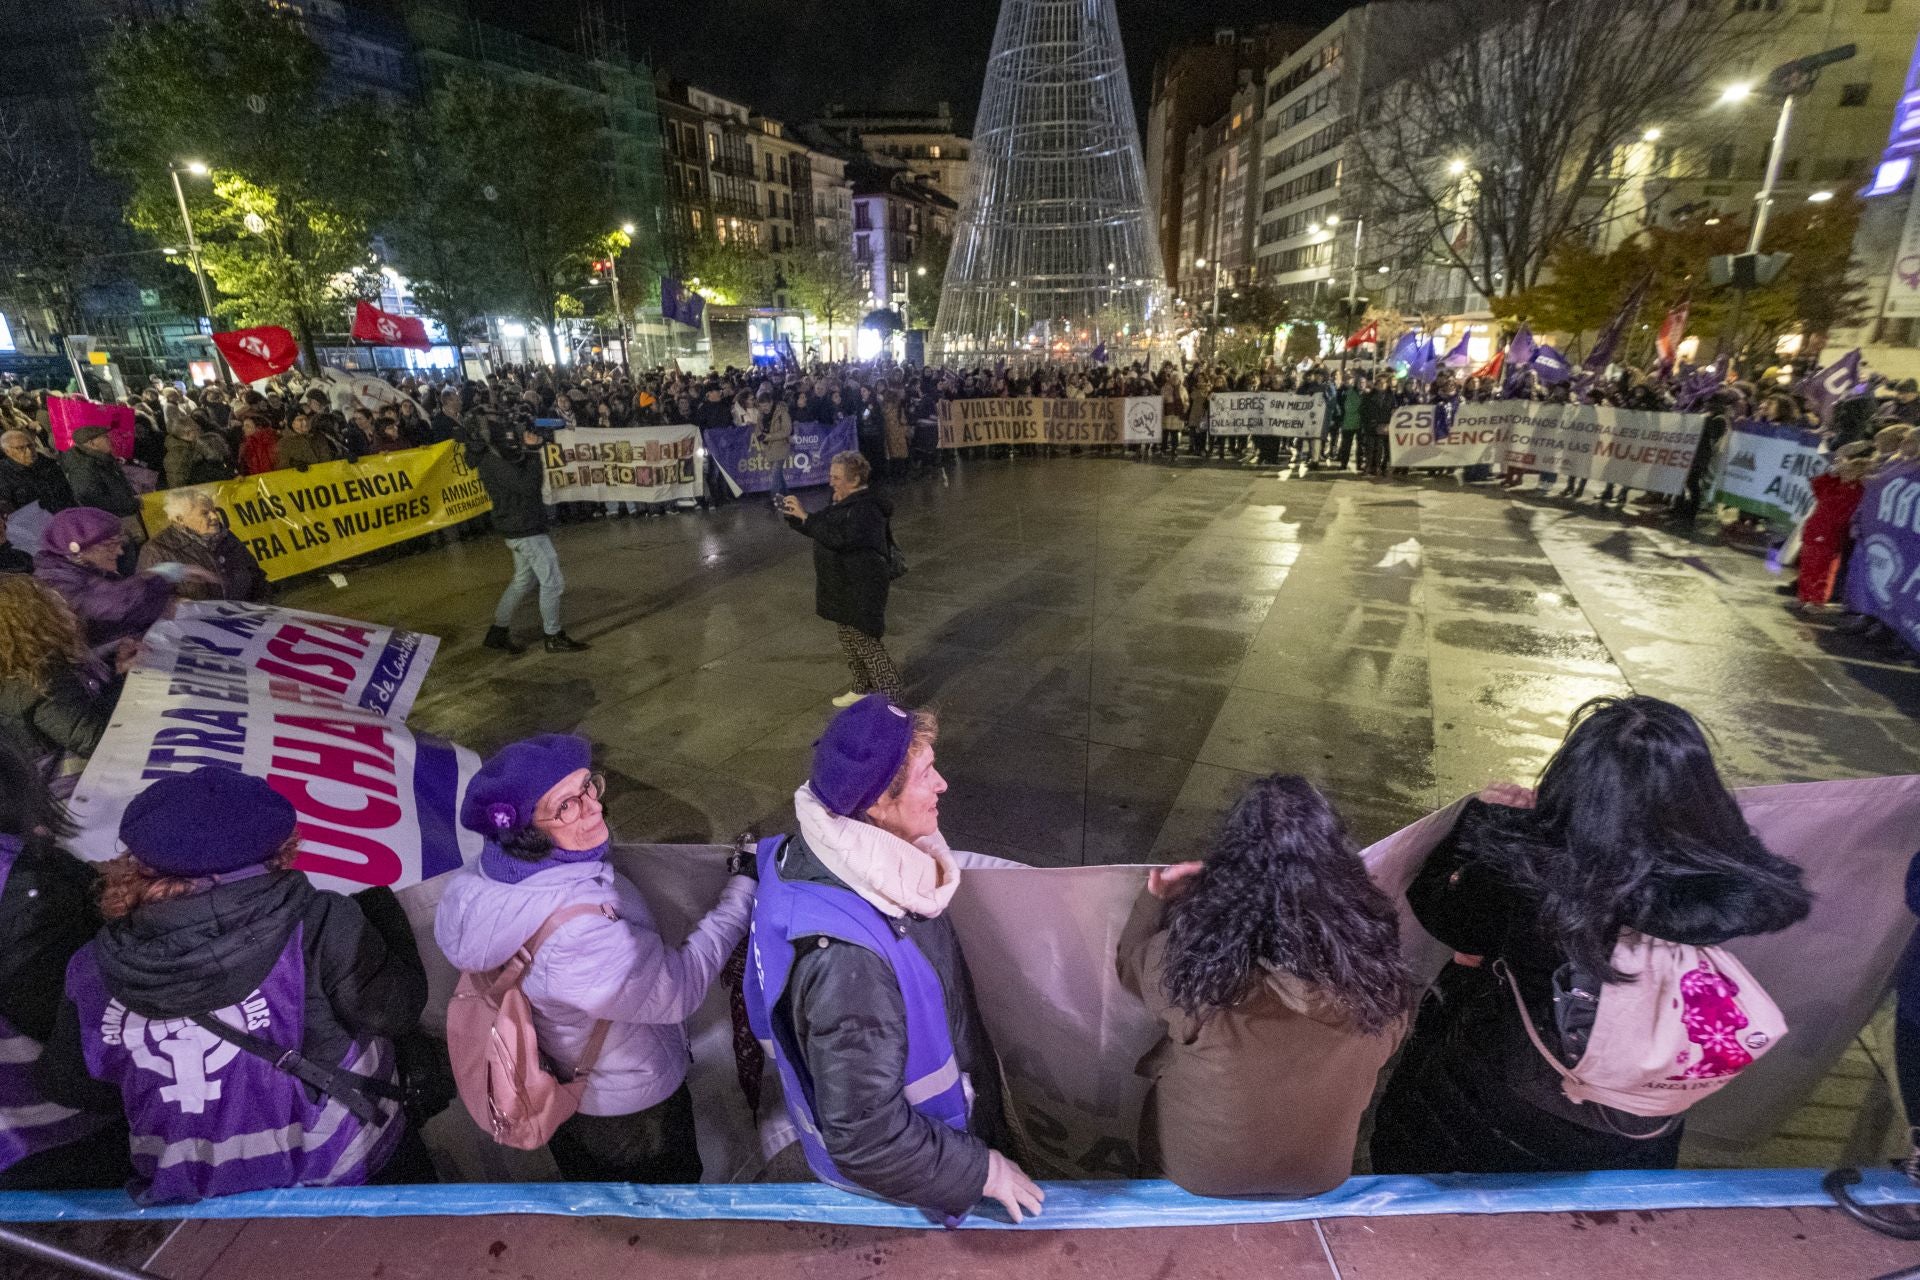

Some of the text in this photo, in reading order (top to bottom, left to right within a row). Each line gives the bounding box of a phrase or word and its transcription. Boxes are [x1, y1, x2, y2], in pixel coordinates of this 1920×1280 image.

[961, 400, 1033, 419] VIOLENCIAS
[1043, 400, 1114, 420] MACHISTAS
[1230, 397, 1314, 411] LIBRES SIN MIEDO
[943, 424, 954, 443] NI
[963, 420, 1038, 443] ACTITUDES
[1458, 415, 1487, 427] POR
[1593, 440, 1696, 469] MUJERES
[234, 491, 286, 527] MÁS
[288, 470, 413, 514] VIOLENCIA
[288, 521, 331, 552] LAS
[336, 495, 431, 540] MUJERES
[371, 680, 395, 702] de
